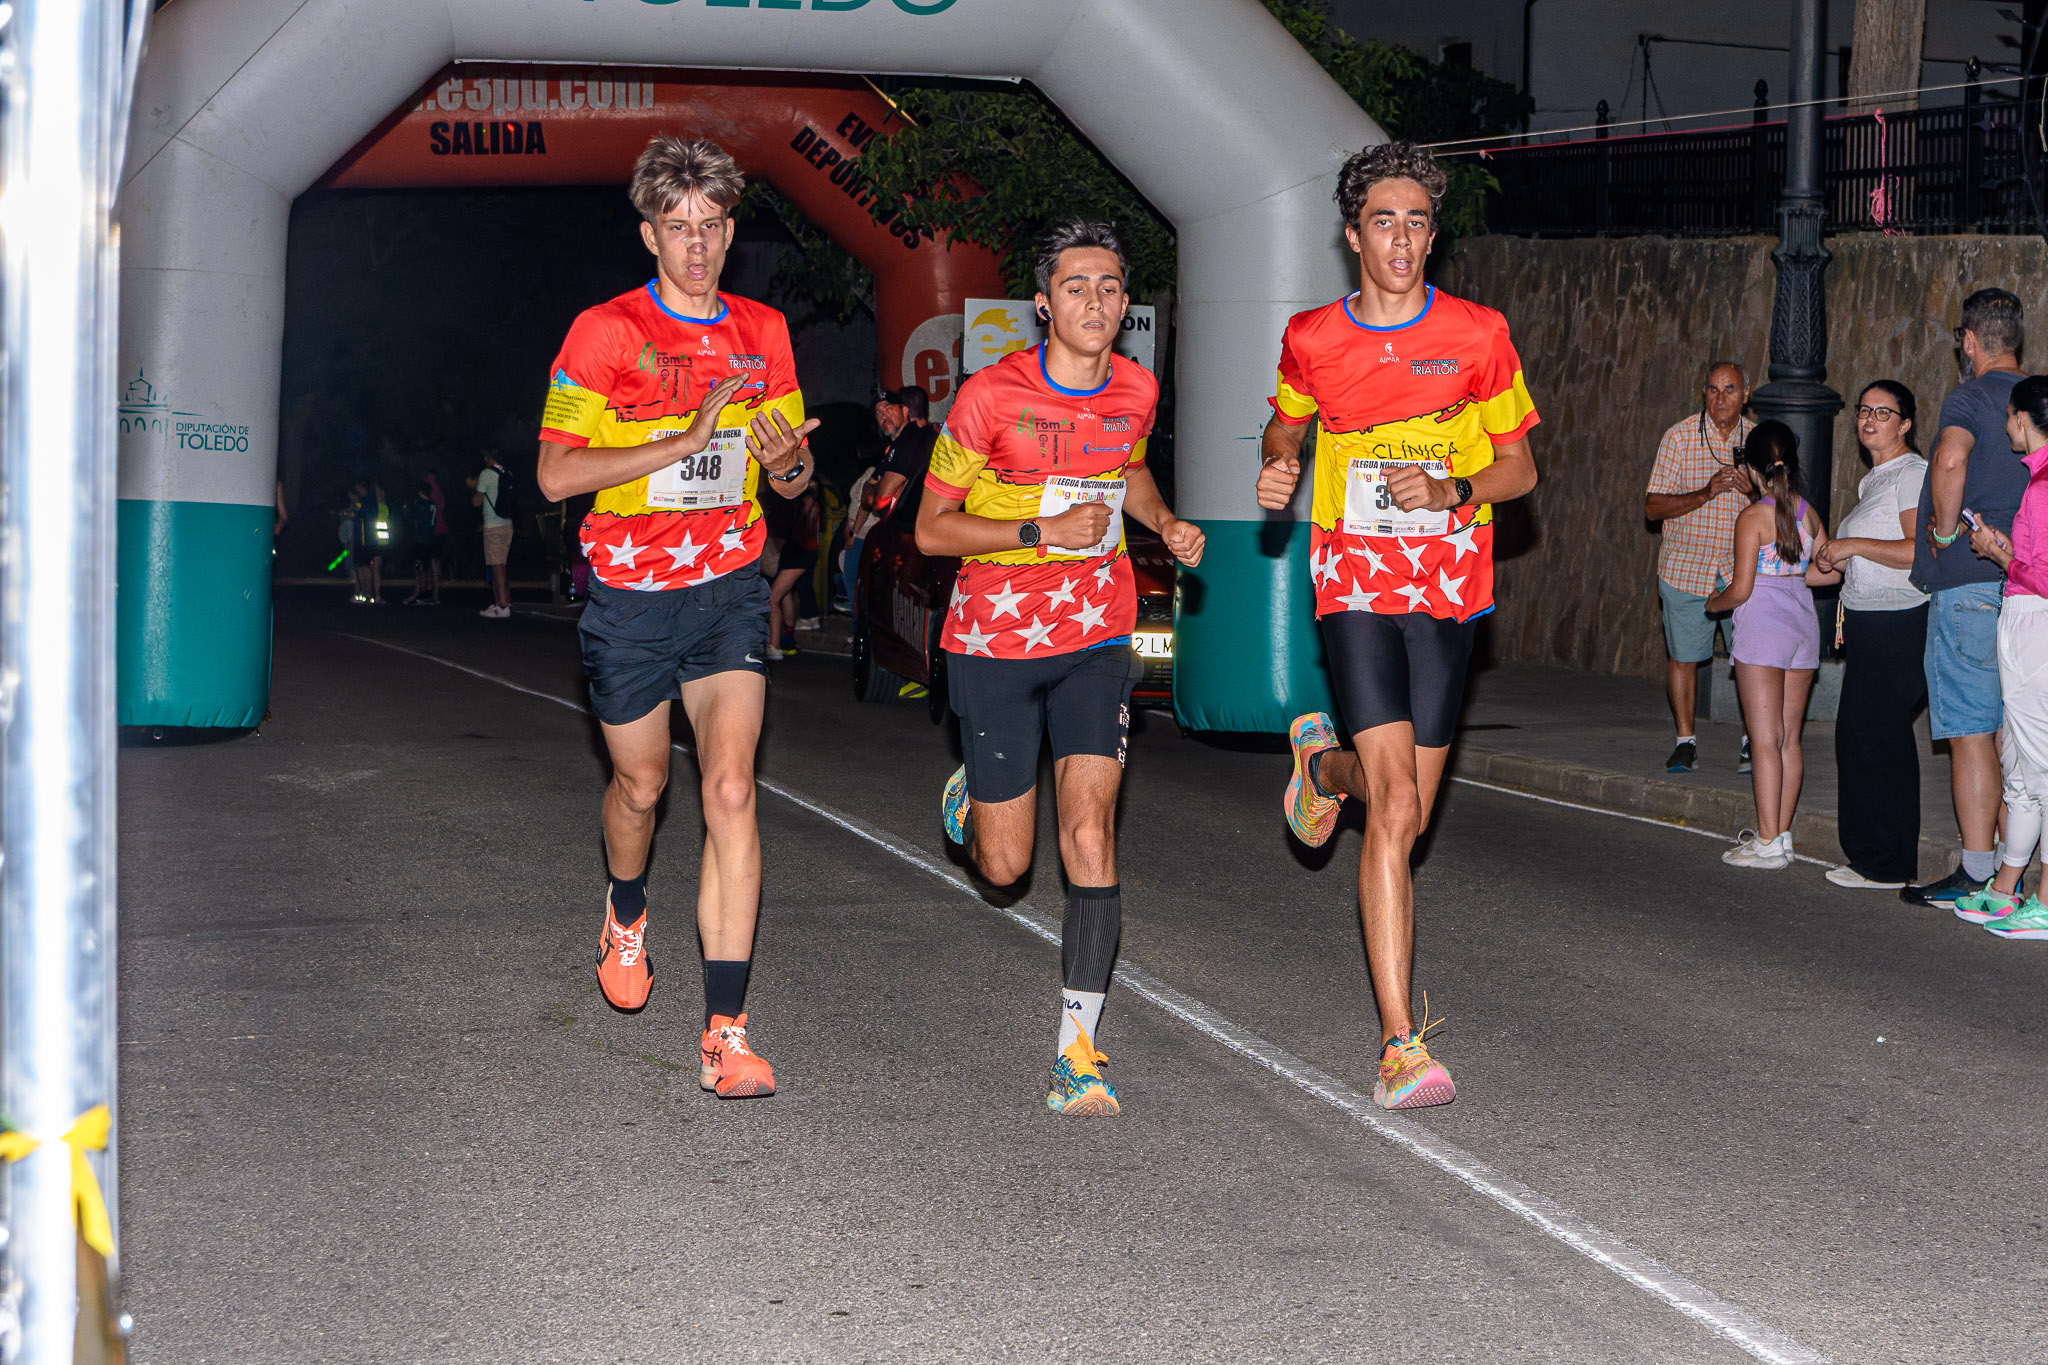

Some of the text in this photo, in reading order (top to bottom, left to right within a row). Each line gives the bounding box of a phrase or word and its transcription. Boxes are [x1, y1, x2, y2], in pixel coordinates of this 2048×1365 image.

[414, 66, 654, 116] .e3pd.com
[430, 121, 547, 155] SALIDA
[176, 422, 249, 435] DIPUTACIÓN DE
[176, 433, 249, 453] TOLEDO
[1372, 440, 1459, 459] CLÍNICA
[680, 454, 722, 481] 348
[1057, 477, 1079, 488] LEGUA
[1080, 480, 1110, 489] NOCTURNA
